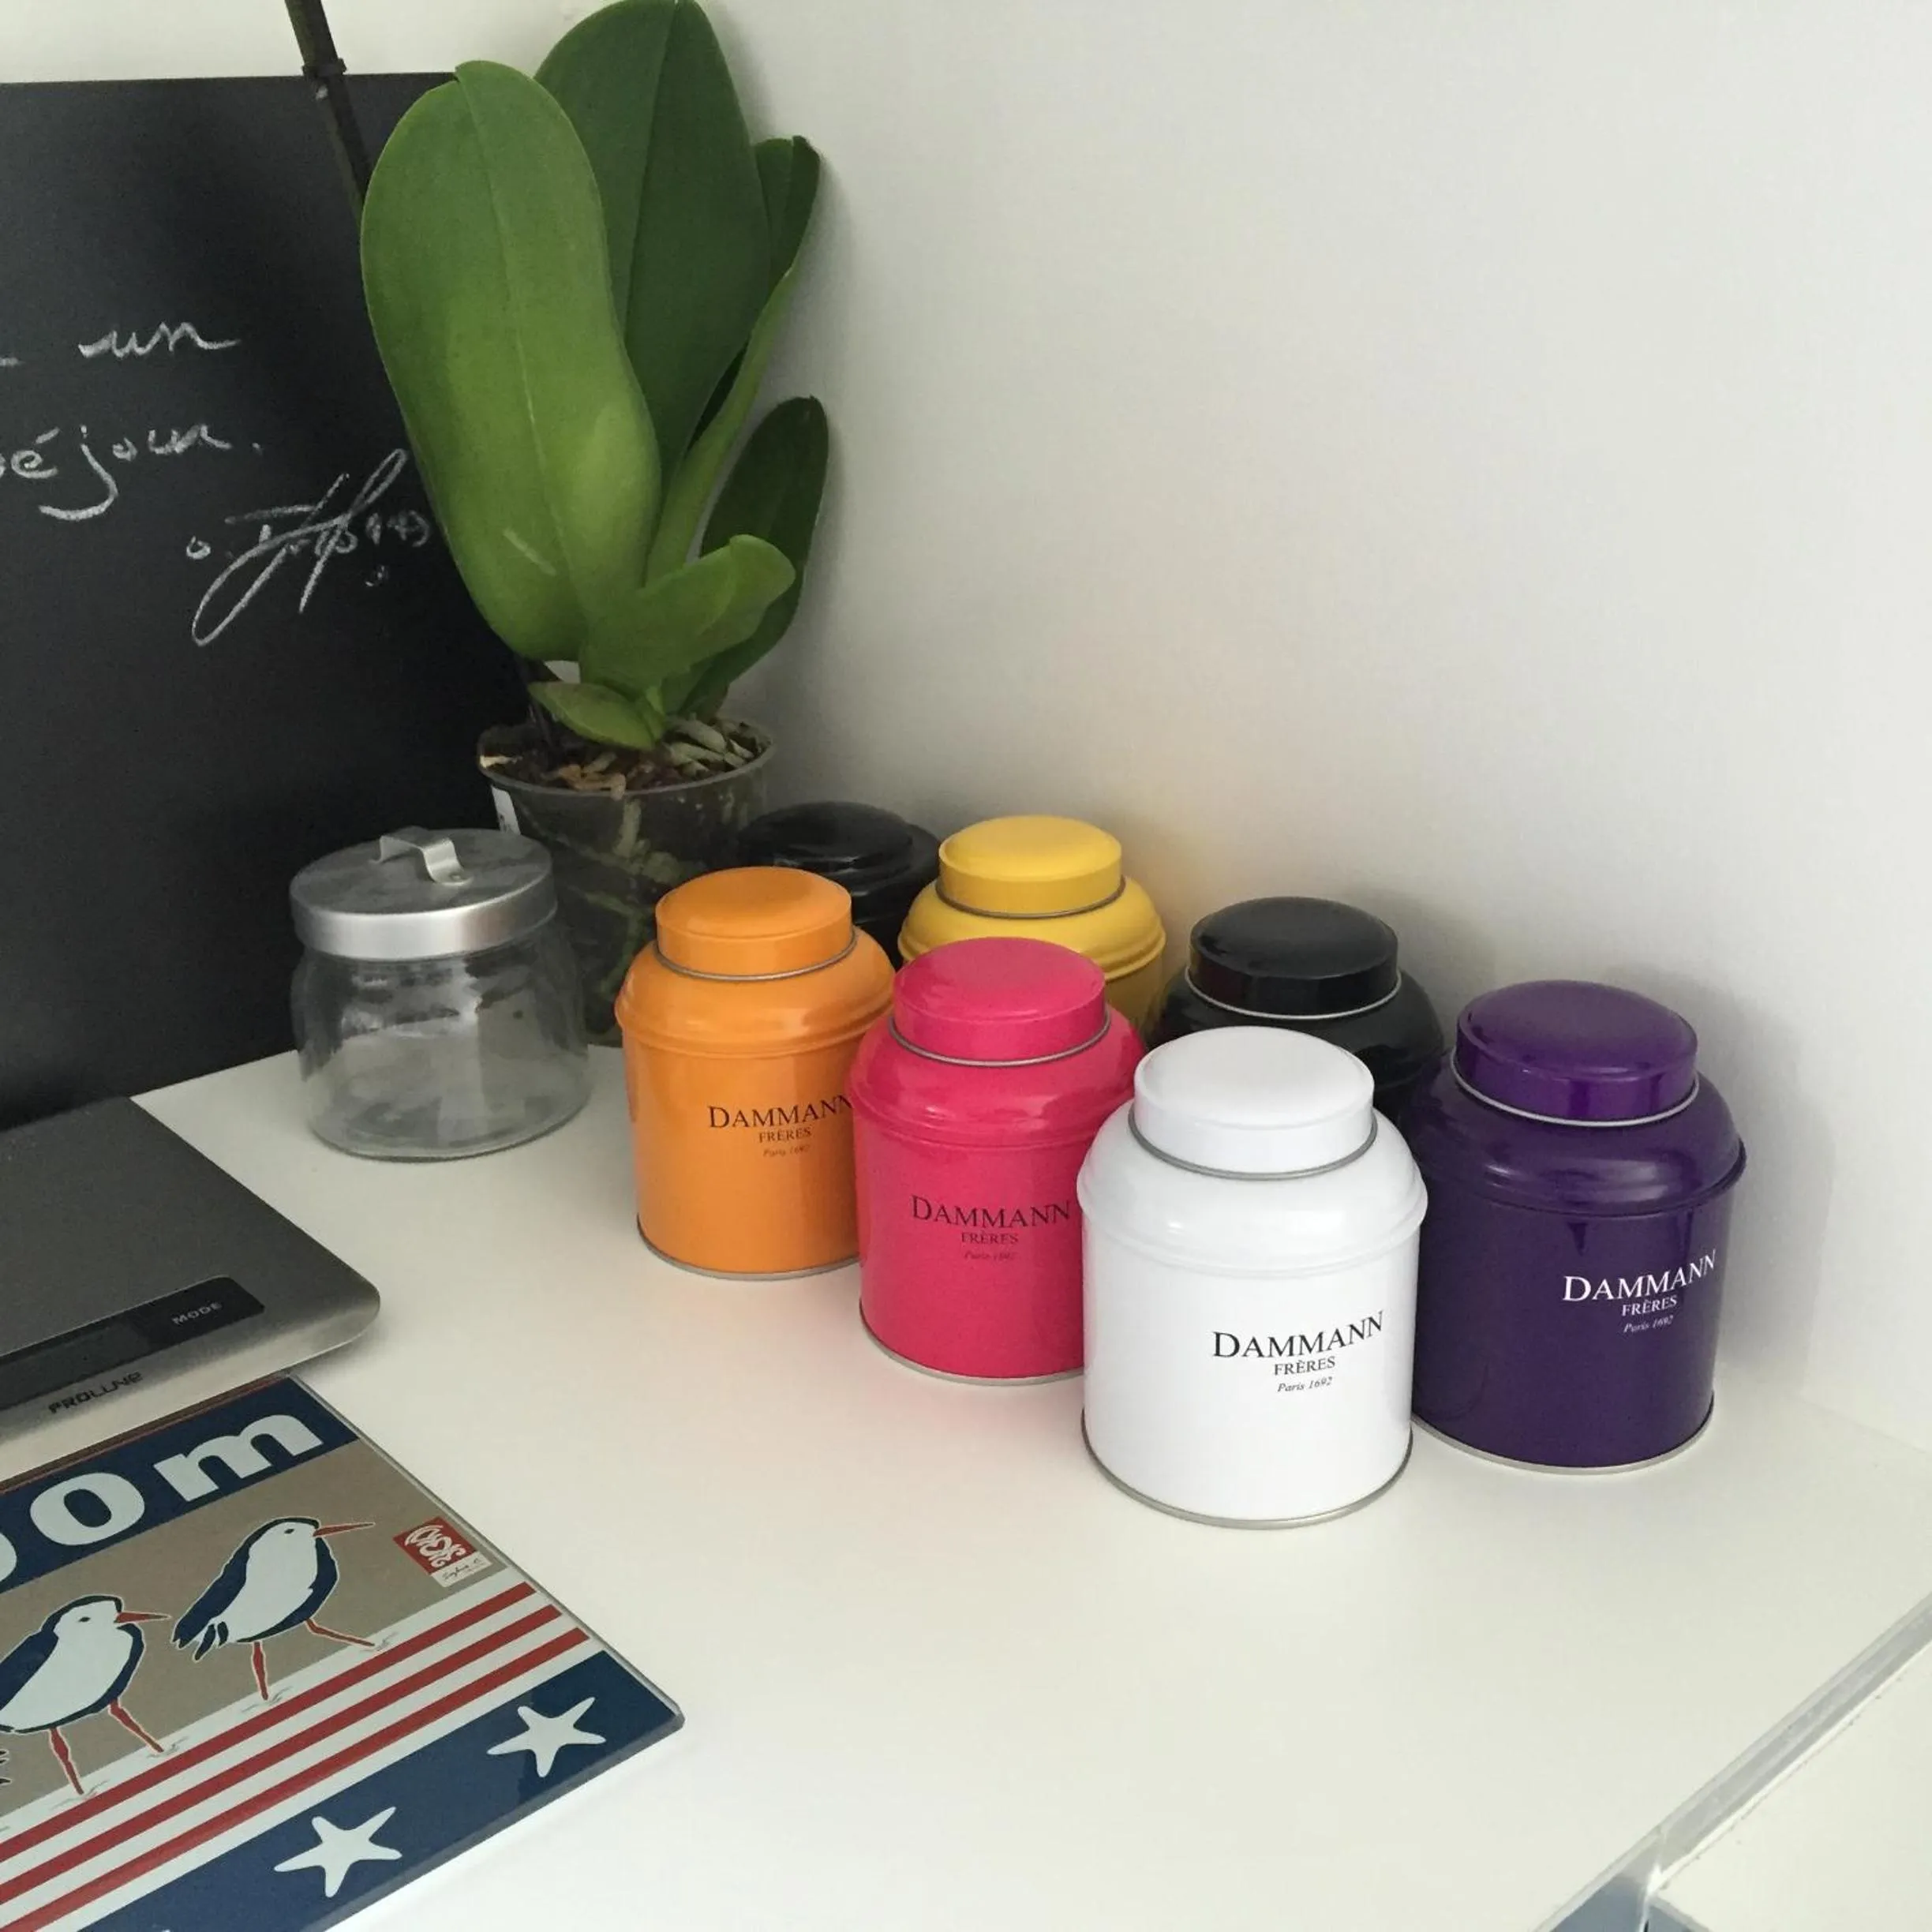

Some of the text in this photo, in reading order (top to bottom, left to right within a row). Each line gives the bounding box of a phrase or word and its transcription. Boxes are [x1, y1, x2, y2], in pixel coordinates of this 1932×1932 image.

[707, 1095, 853, 1129] DAMMANN
[912, 1195, 1071, 1229] DAMMANN
[960, 1230, 1019, 1245] FRÈRES
[1562, 1249, 1717, 1301] DAMMANN
[171, 1301, 223, 1327] MODE
[1621, 1294, 1678, 1316] FRÈRES
[1211, 1309, 1383, 1358] DAMMANN
[1274, 1356, 1336, 1376] FRÈRES
[1277, 1376, 1334, 1392] Paris 1692
[0, 1414, 324, 1582] om
